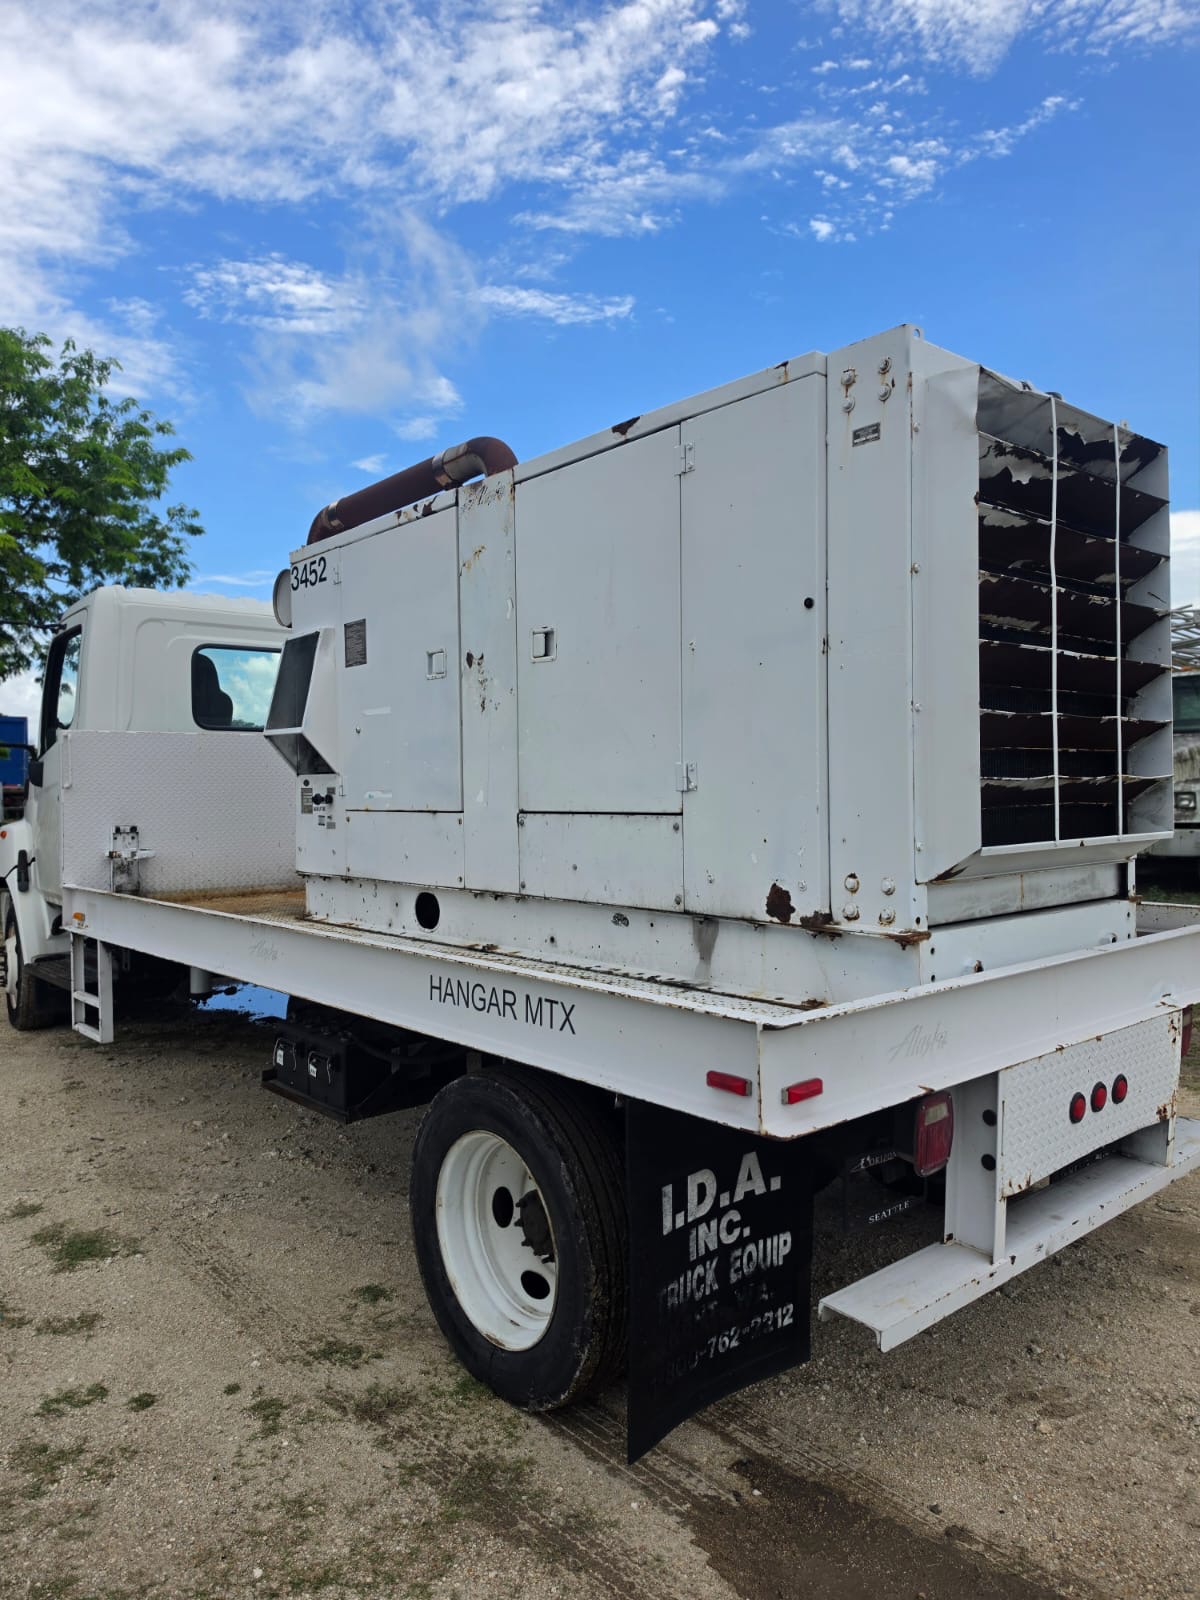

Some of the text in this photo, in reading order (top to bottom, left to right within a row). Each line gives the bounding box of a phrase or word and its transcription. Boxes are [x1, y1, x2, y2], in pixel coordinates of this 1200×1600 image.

[290, 556, 328, 592] 3452
[429, 974, 576, 1035] HANGAR MTX
[661, 1151, 782, 1236] I.D.A.
[868, 1200, 911, 1224] SEATTLE
[689, 1209, 750, 1261] INC.
[729, 1231, 792, 1284] EQUIP
